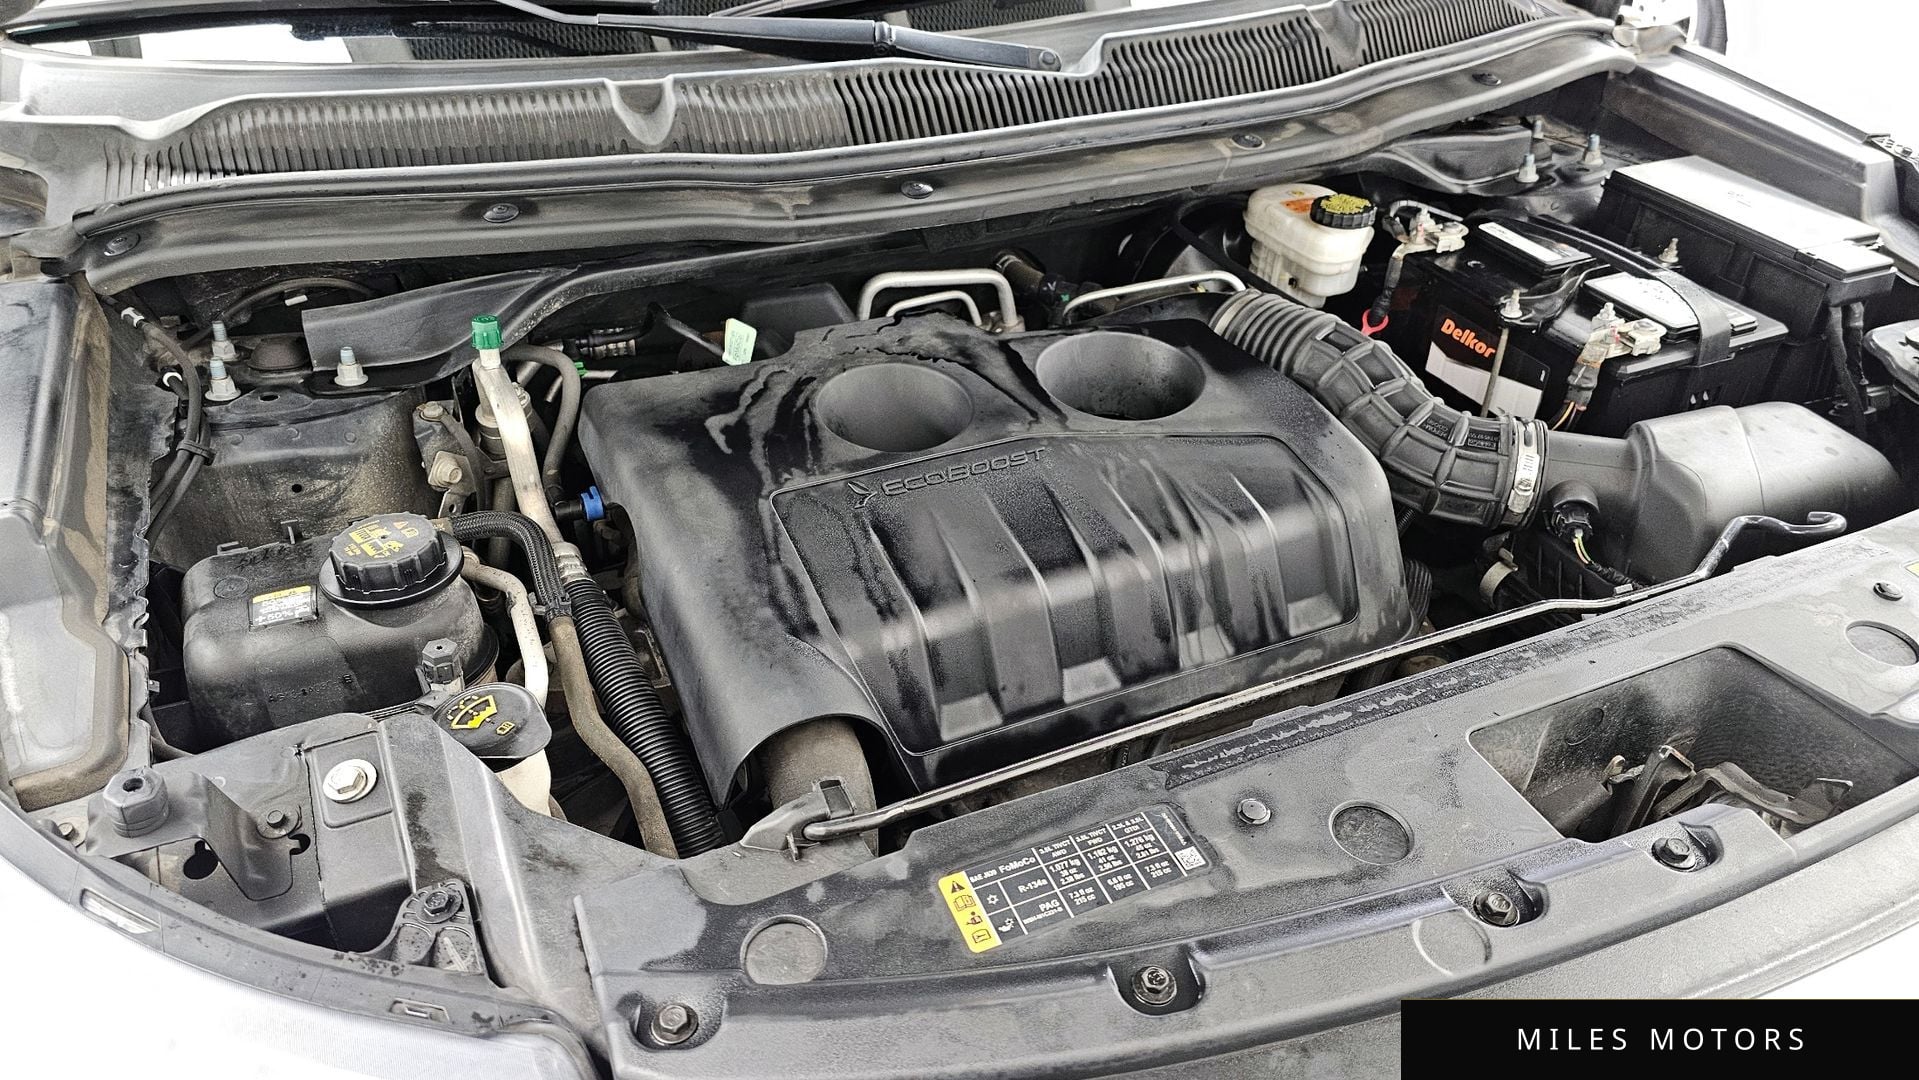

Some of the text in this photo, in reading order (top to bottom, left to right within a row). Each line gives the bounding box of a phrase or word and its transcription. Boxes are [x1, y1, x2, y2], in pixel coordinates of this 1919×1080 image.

[1441, 318, 1496, 359] Delkor
[1106, 846, 1118, 854] kg
[998, 856, 1036, 874] FoMoCo
[1049, 858, 1081, 873] 1.077 kg
[1018, 878, 1048, 894] R-134a
[1038, 899, 1060, 912] PAG
